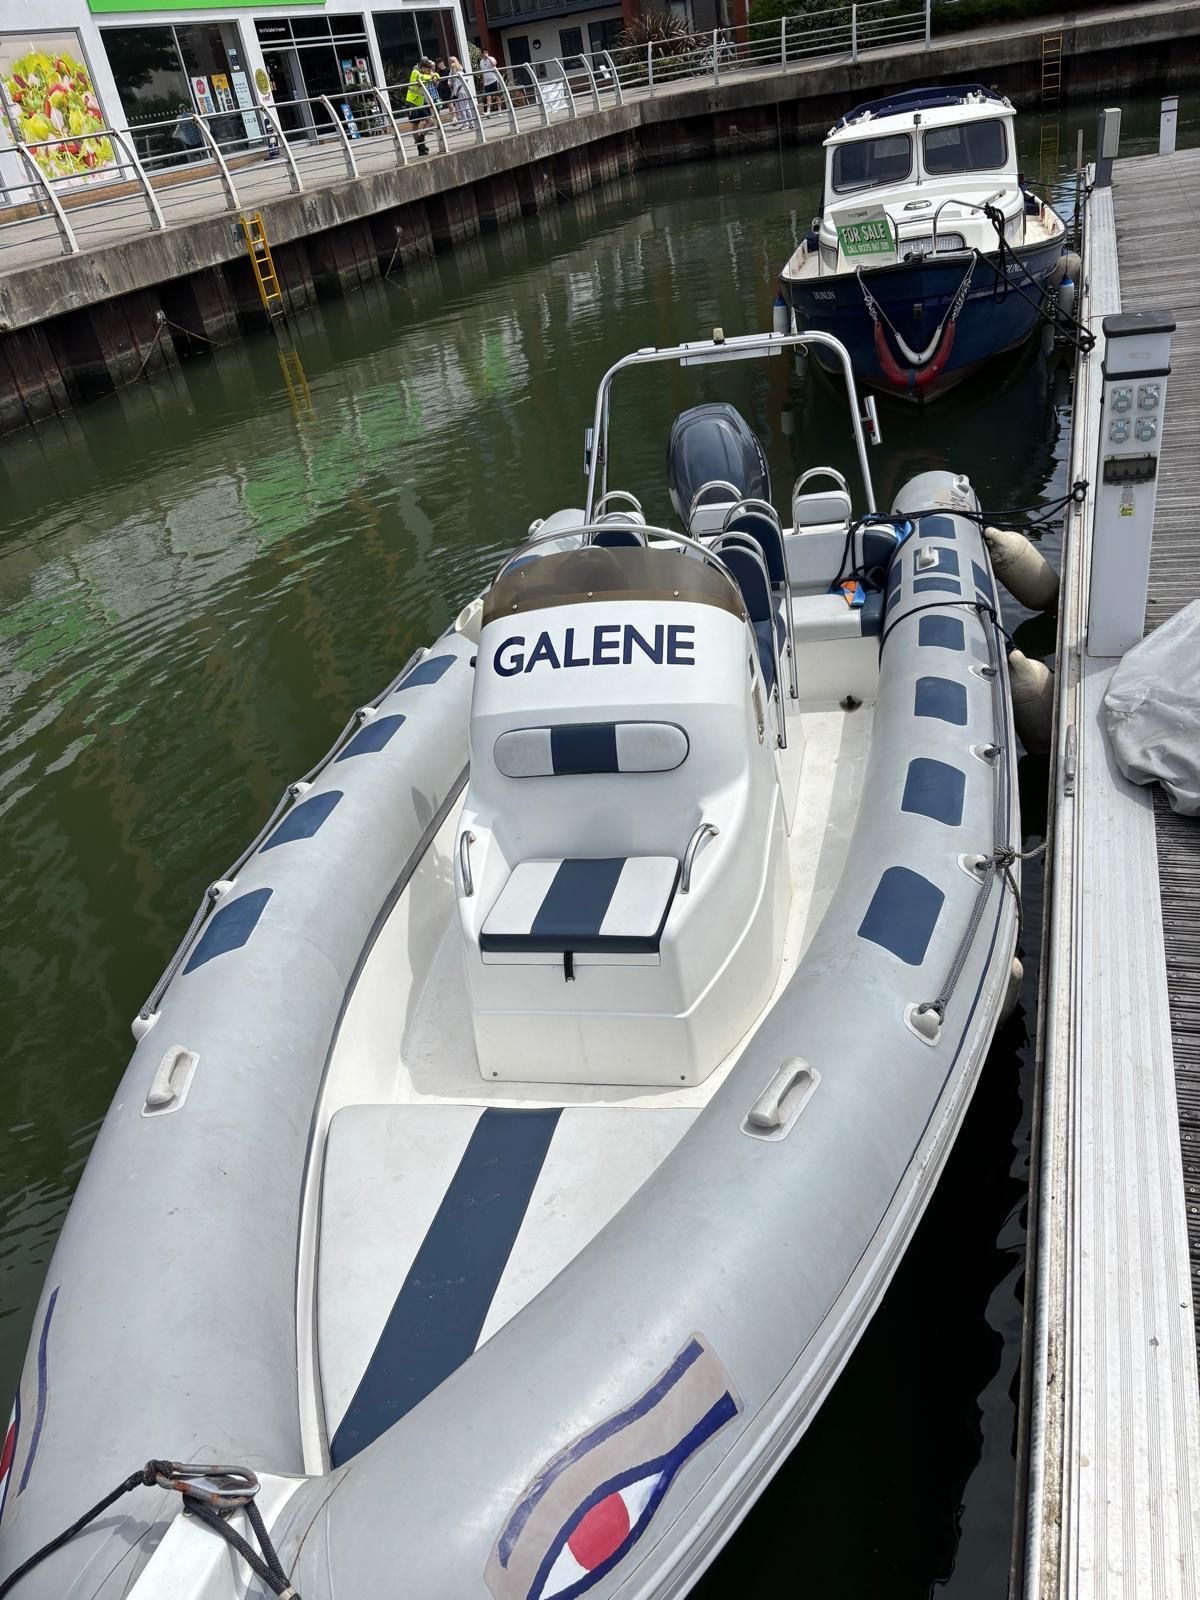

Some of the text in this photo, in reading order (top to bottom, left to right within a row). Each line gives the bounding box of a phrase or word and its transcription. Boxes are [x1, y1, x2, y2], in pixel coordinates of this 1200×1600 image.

[841, 223, 886, 244] FOR SALE
[847, 245, 858, 254] CALL
[812, 291, 836, 300] DUNLIN
[493, 624, 696, 677] GALENE
